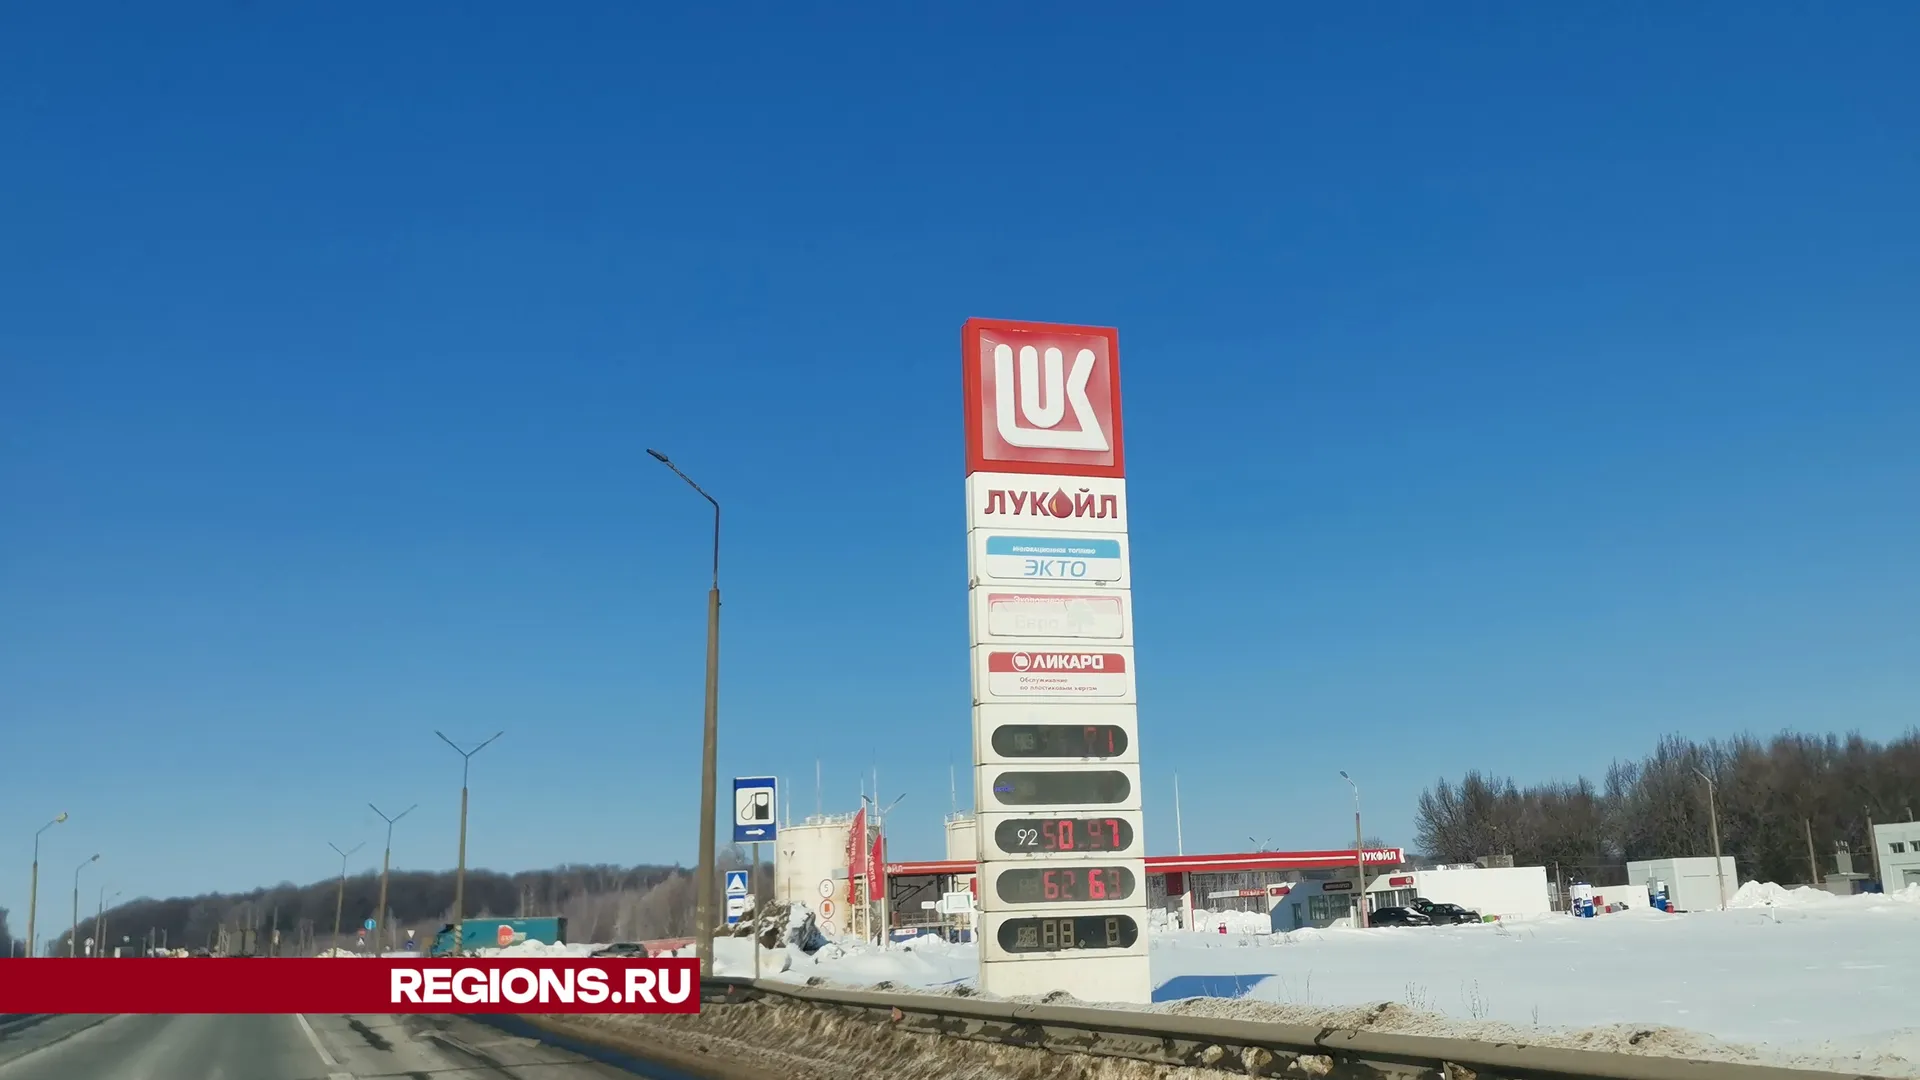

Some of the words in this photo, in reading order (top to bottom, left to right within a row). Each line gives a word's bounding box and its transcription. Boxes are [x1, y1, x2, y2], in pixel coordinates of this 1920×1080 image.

[984, 486, 1118, 519] ЛУКОЙЛ
[1024, 559, 1087, 577] ЭКТО
[1033, 654, 1104, 670] ЛИКАРД
[1017, 828, 1038, 846] 92
